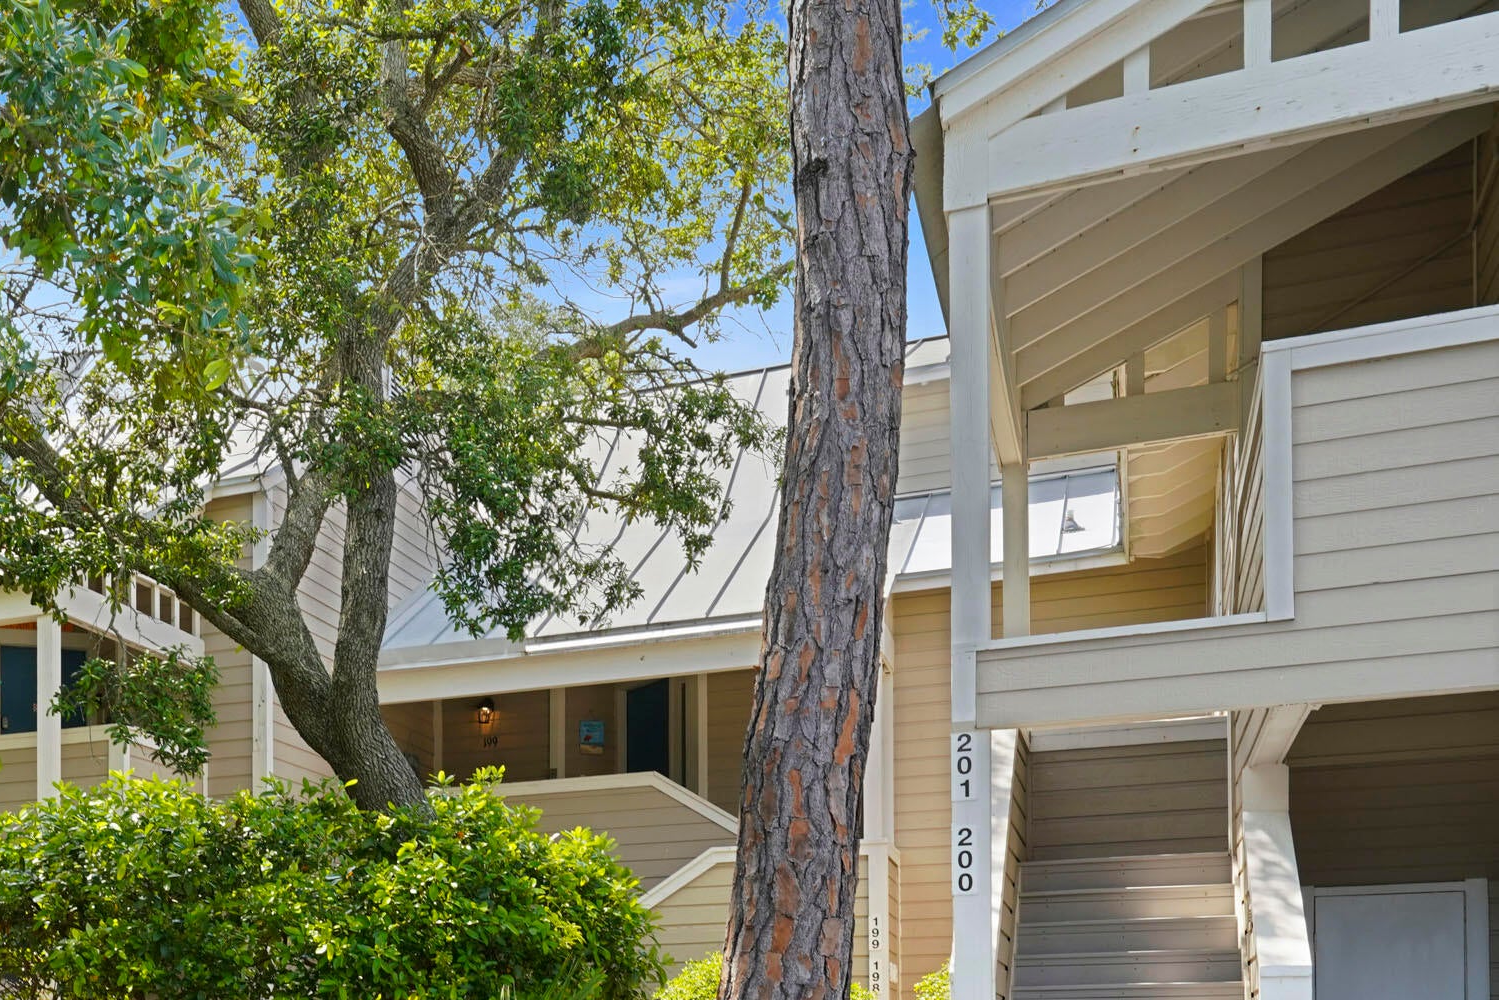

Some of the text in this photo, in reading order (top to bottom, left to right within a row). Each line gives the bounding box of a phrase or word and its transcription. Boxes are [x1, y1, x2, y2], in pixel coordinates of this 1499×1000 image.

[957, 733, 972, 798] 201
[957, 827, 973, 892] 200
[872, 916, 880, 949] 199
[872, 961, 880, 992] 198
